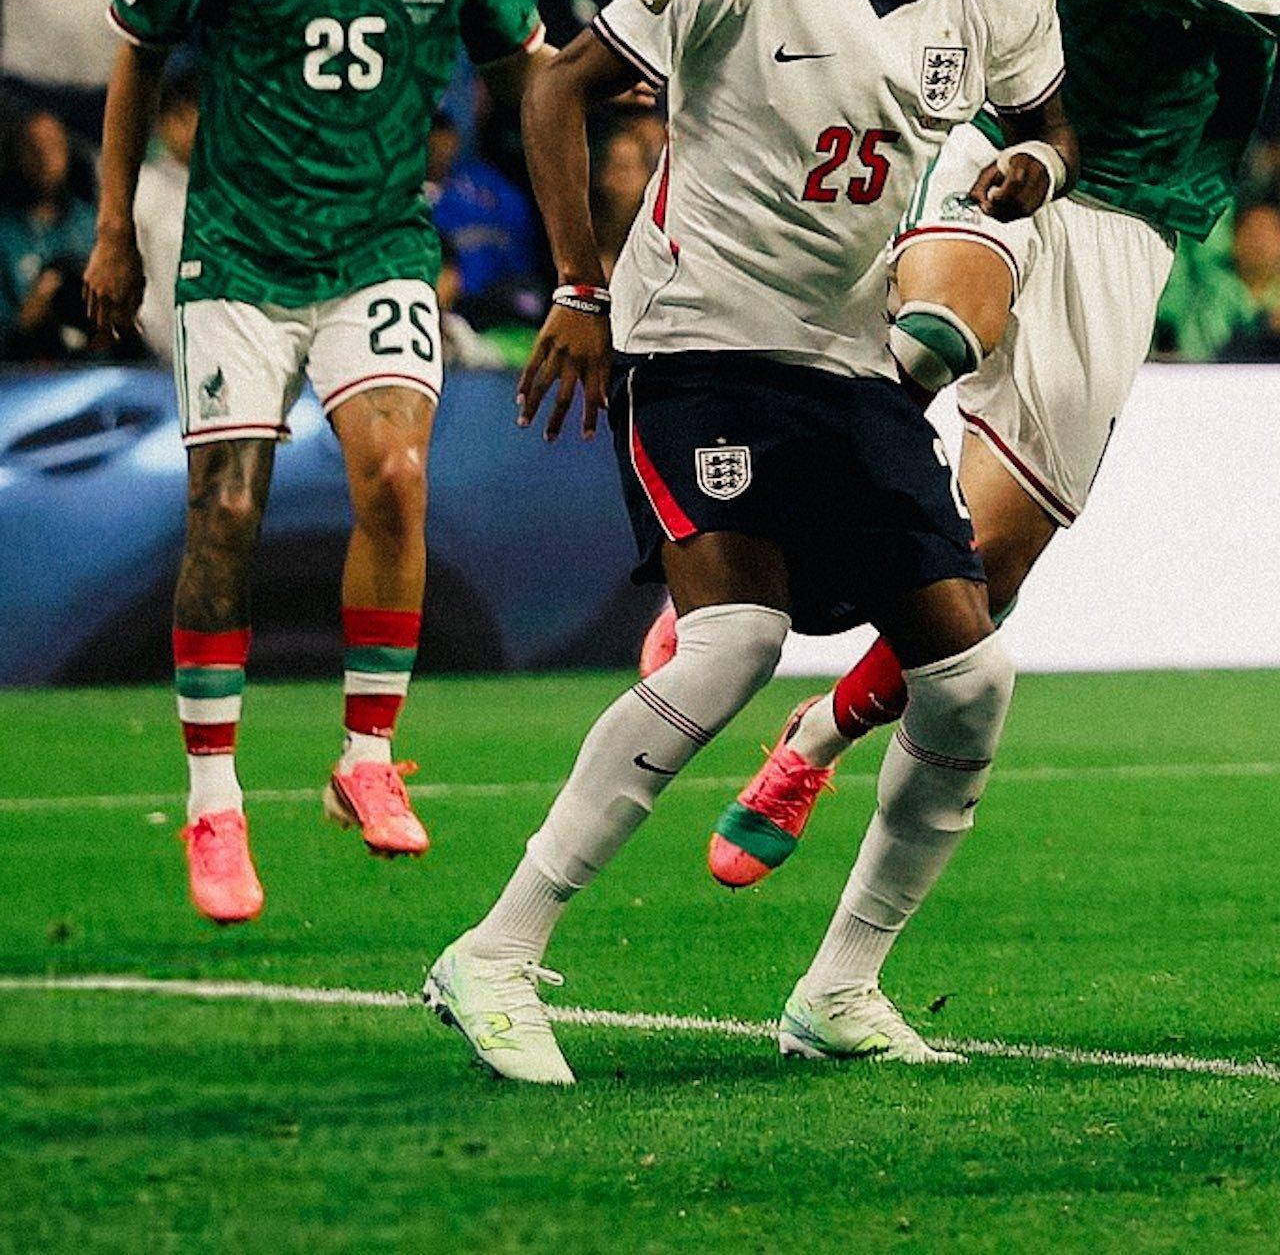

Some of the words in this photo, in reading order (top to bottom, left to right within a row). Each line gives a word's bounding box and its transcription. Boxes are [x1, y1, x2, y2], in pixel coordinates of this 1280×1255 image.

[303, 16, 387, 90] 25
[802, 126, 901, 204] 25
[368, 298, 433, 362] 25
